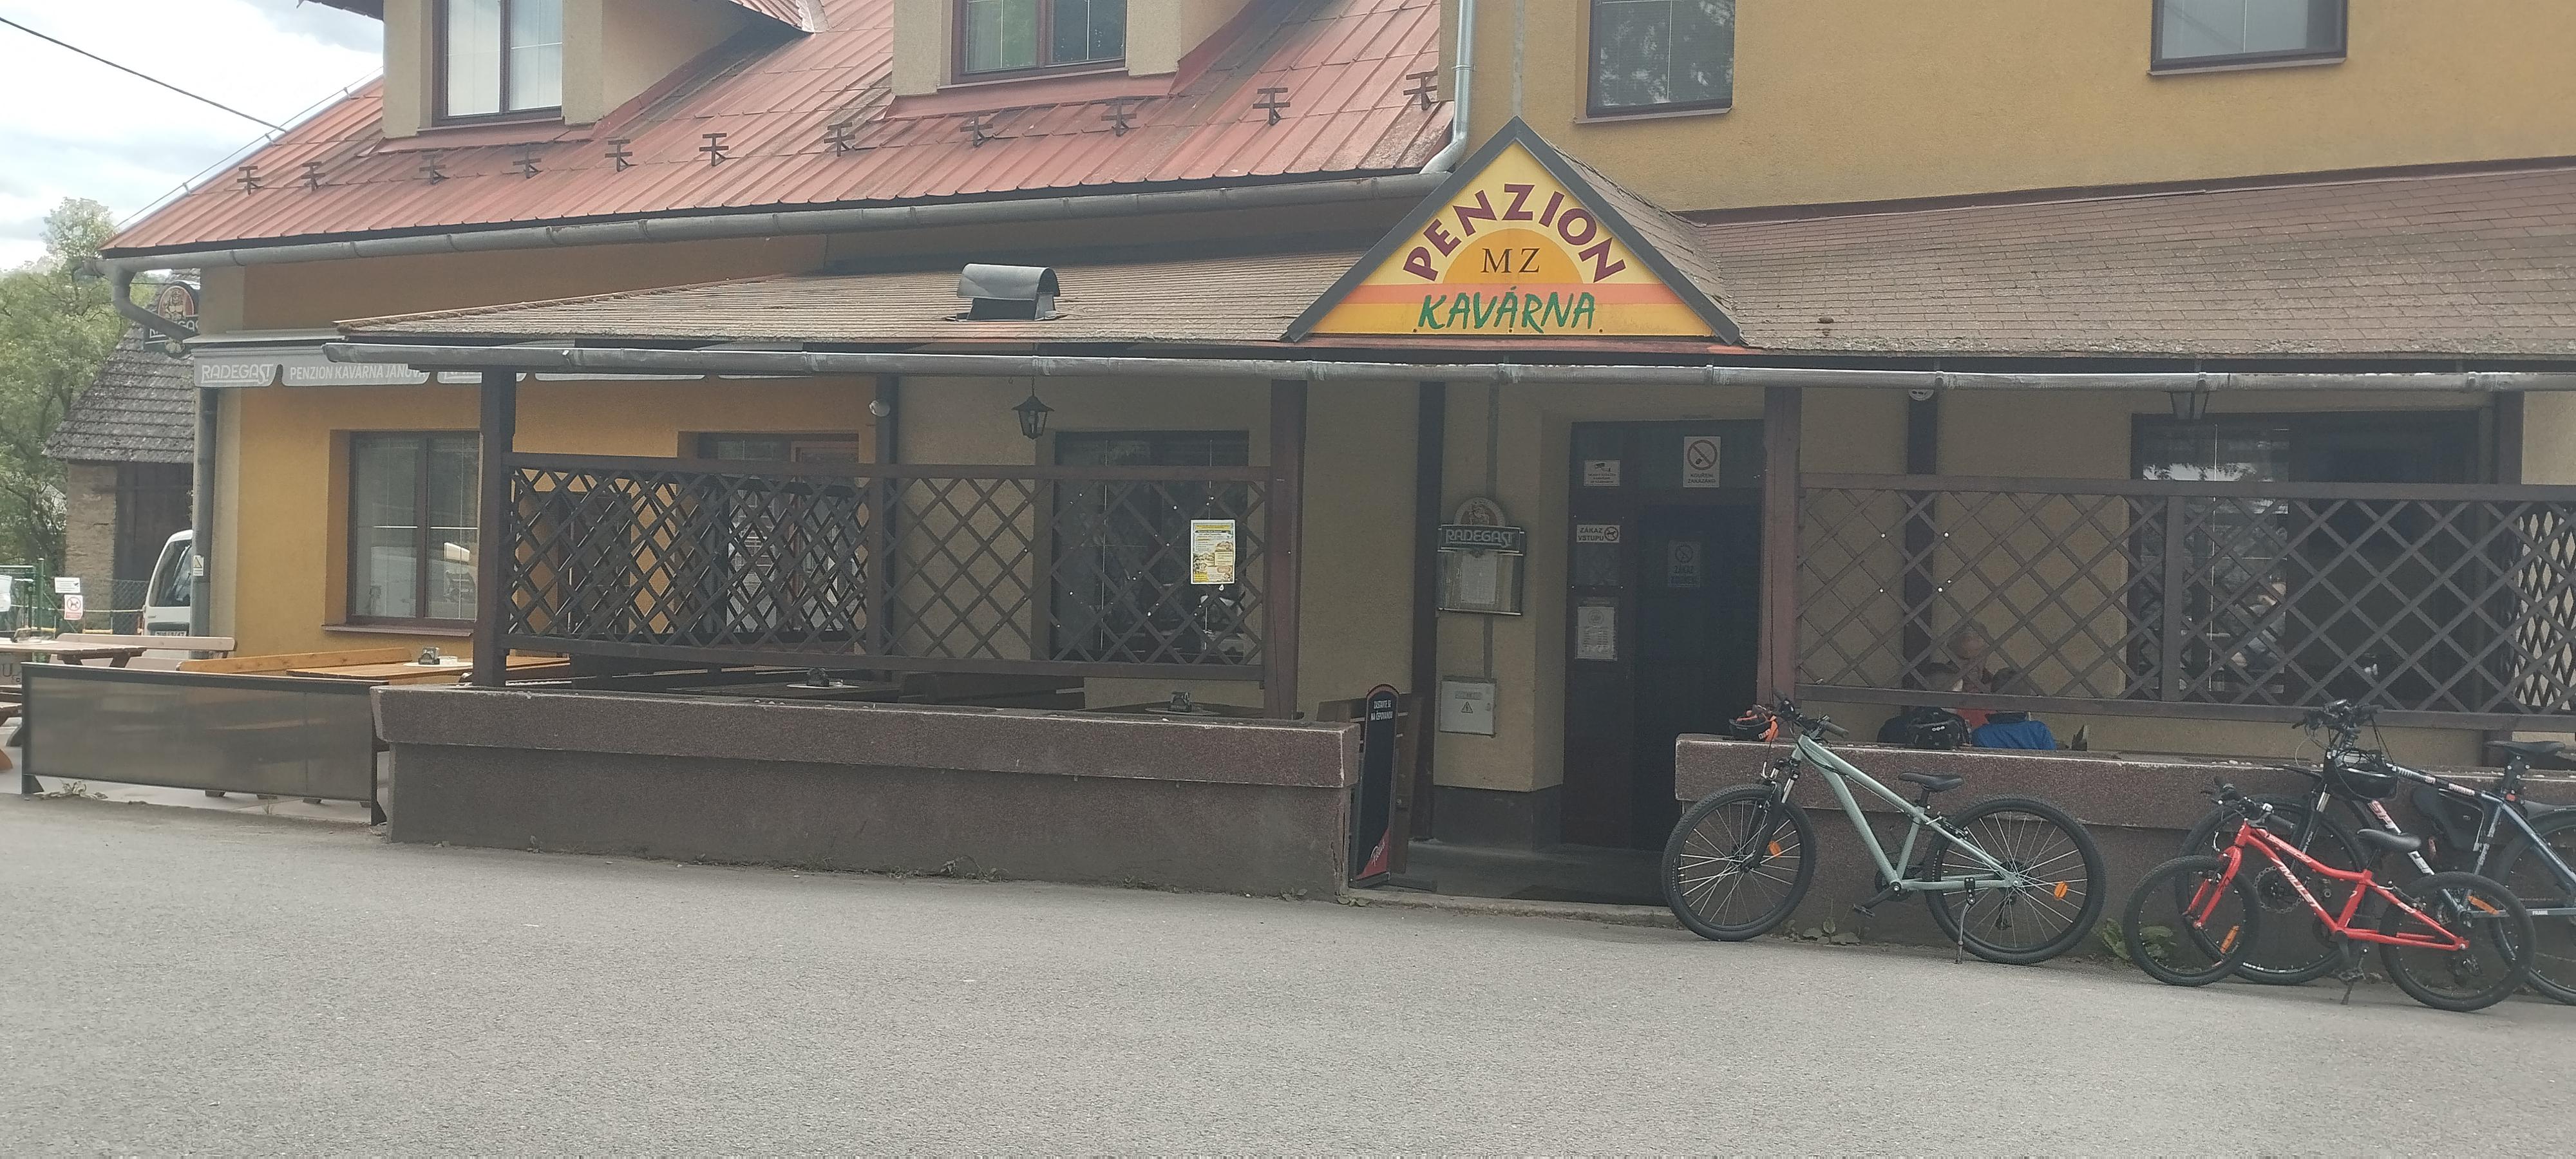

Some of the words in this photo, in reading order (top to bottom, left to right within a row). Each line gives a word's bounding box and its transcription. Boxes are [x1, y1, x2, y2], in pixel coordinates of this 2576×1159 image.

[1403, 184, 1626, 282] PENZION
[1417, 287, 1595, 334] KAVÁRNA
[202, 364, 273, 384] RADEGAST
[290, 366, 330, 380] PENZION
[335, 363, 383, 379] KAVÁRNA
[1445, 529, 1515, 547] RADEGAST
